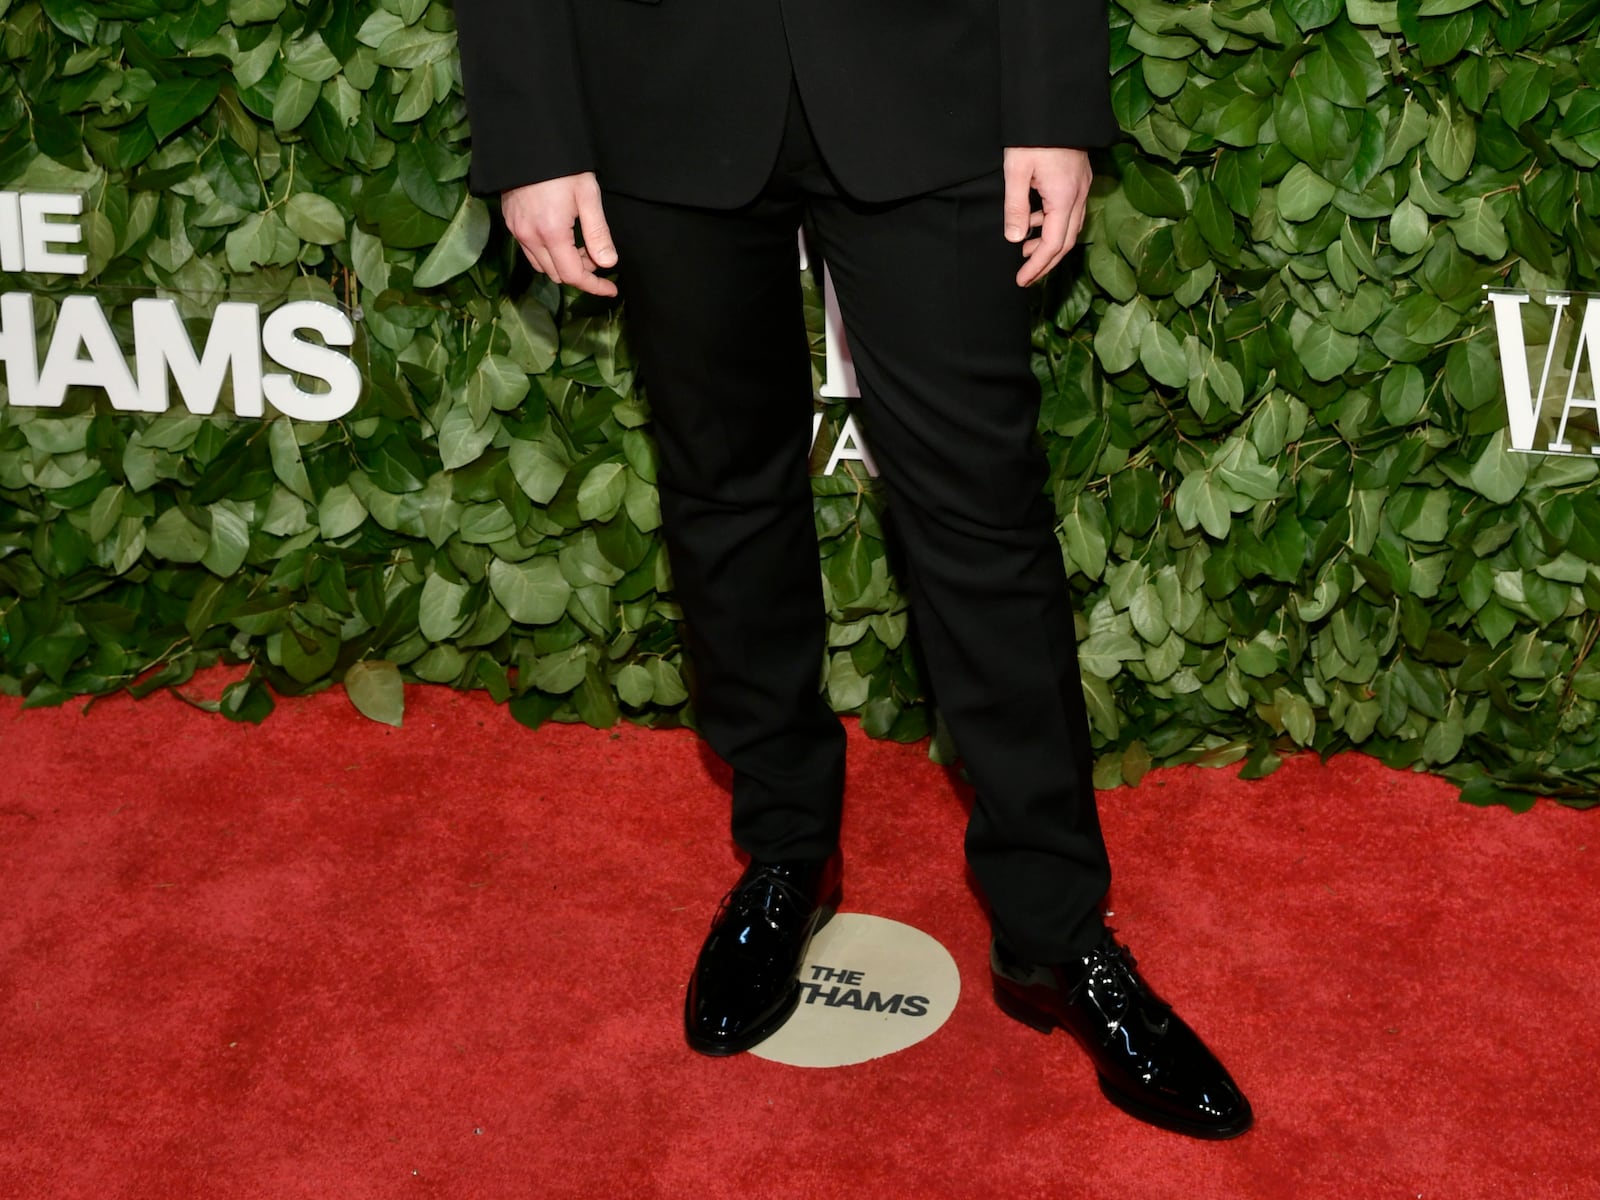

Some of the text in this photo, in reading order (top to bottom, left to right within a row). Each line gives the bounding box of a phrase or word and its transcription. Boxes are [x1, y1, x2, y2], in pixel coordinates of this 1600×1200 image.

[1488, 293, 1600, 454] VA
[808, 412, 881, 478] A
[811, 965, 865, 986] THE
